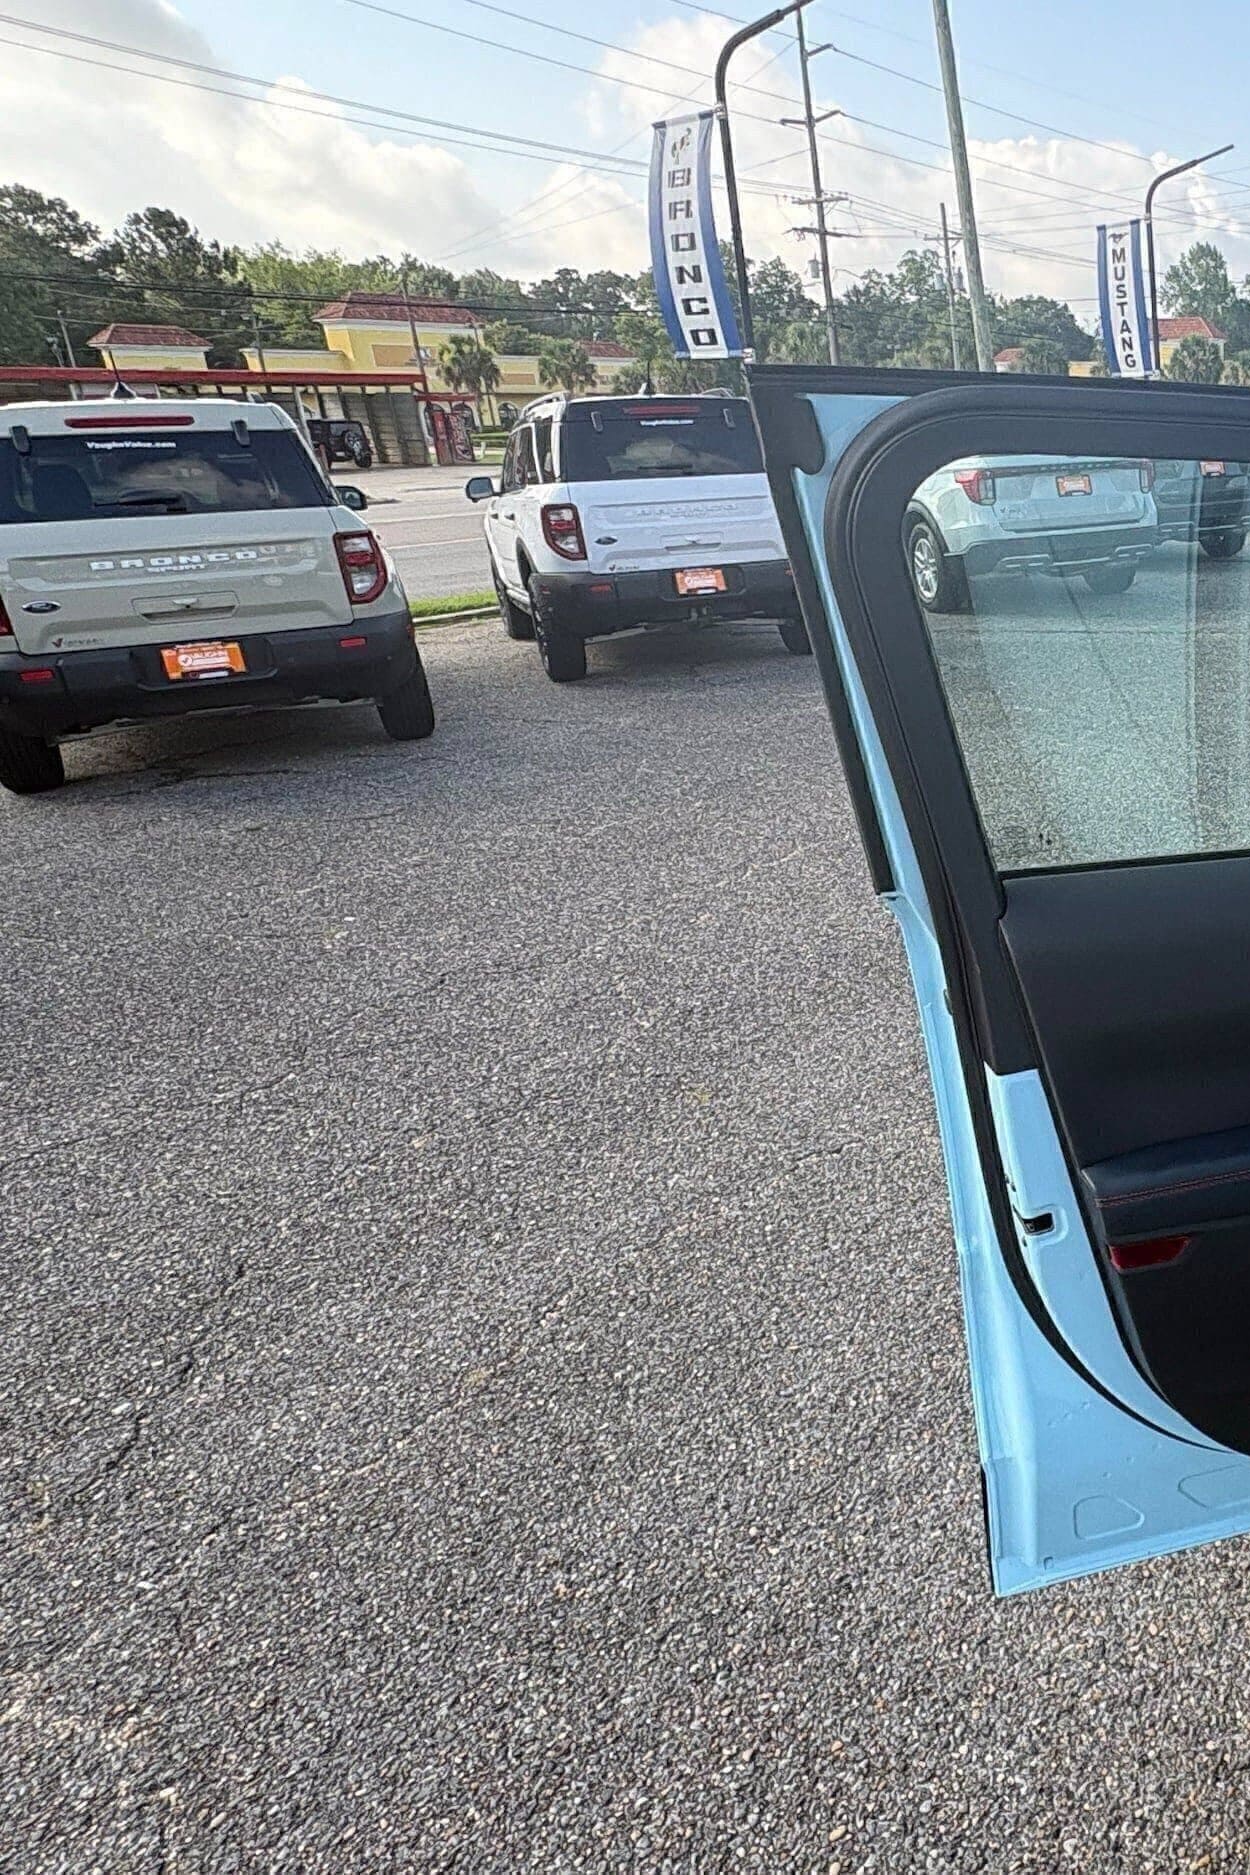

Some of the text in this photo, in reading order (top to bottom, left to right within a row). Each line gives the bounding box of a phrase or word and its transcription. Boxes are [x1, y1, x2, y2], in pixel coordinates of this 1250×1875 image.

[668, 166, 719, 346] BRONCO
[1112, 247, 1137, 369] MUSTANG
[89, 551, 258, 571] BRONCO
